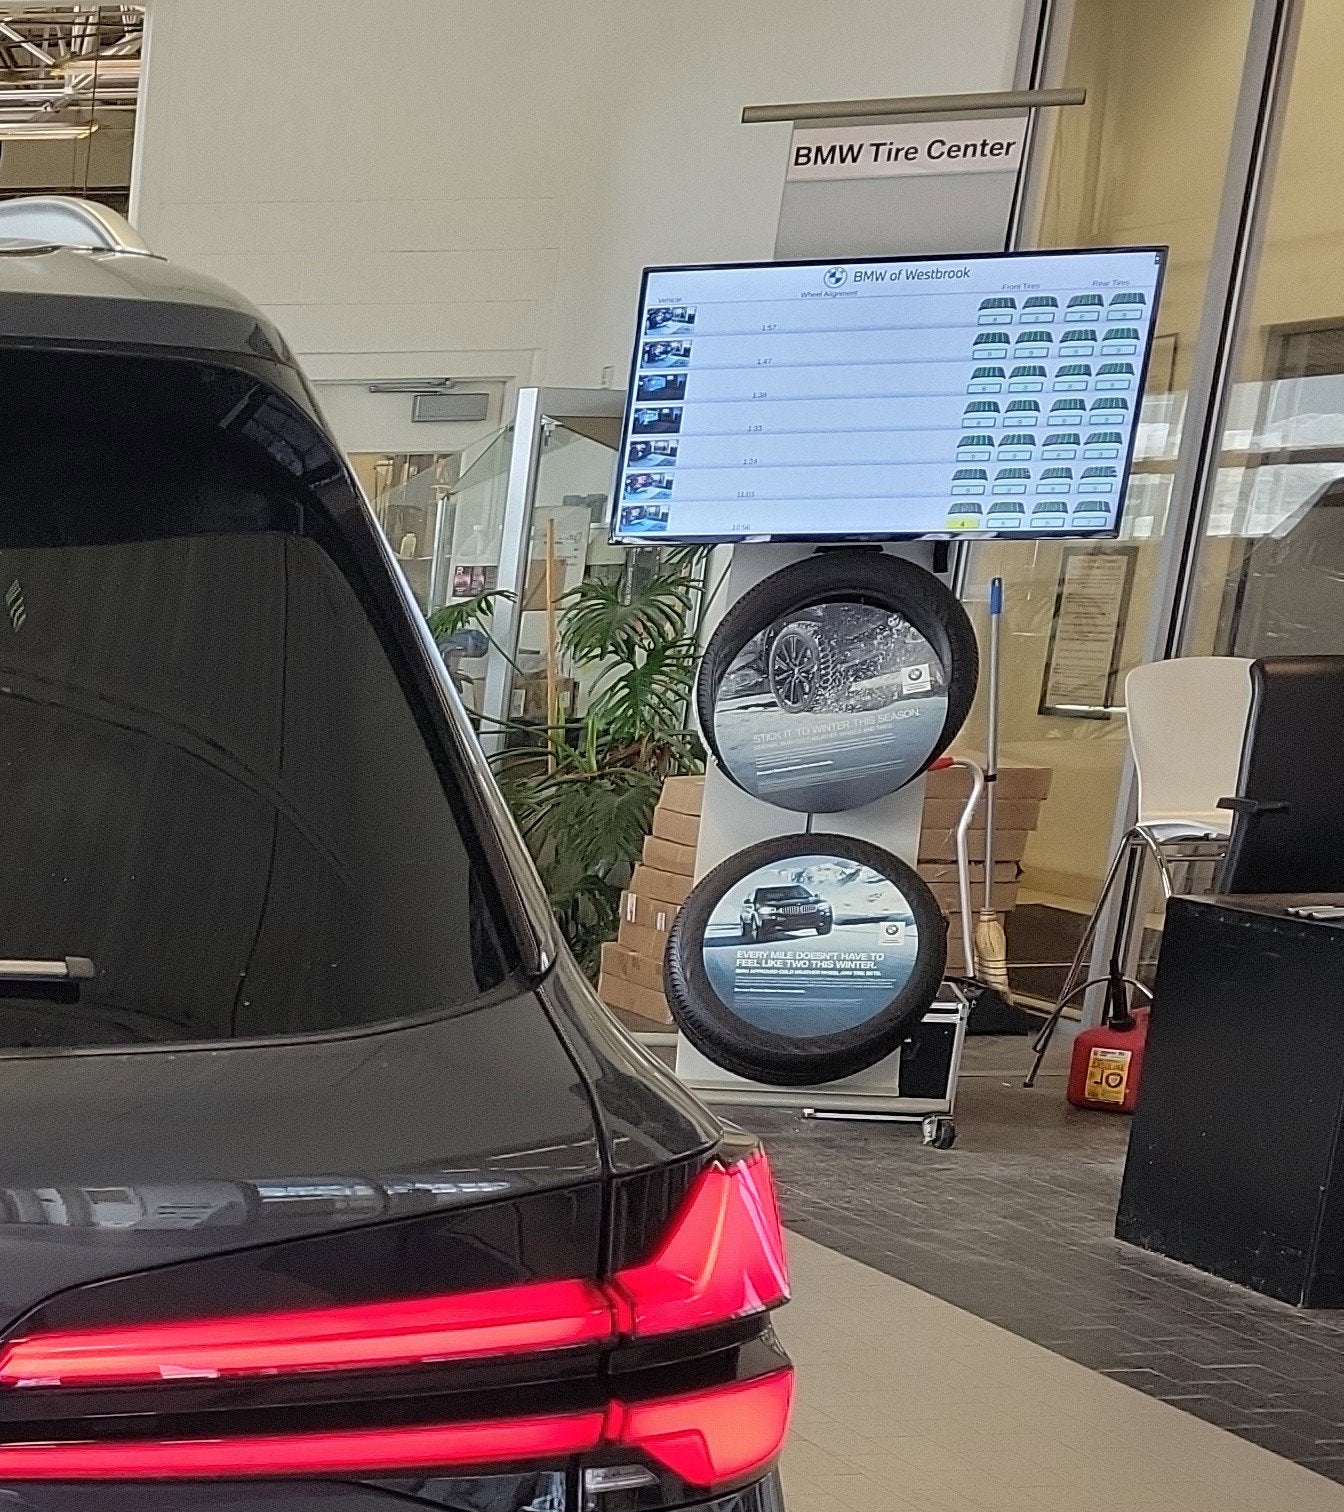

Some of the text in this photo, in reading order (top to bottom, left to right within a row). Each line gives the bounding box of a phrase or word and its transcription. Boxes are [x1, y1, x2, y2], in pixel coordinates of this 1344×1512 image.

[794, 138, 1017, 167] BMW Tire Center
[853, 267, 971, 283] BMW of Westbrook
[823, 290, 858, 299] Alignment
[753, 731, 782, 743] STICK
[796, 727, 810, 736] TO
[812, 720, 850, 733] WINTER
[854, 716, 876, 726] THIS
[878, 708, 922, 722] SEASON.
[737, 951, 884, 960] EVERY MILE DOESN'T HAVE TO
[736, 959, 877, 969] FEEL LIKE TWO THIS WINTER.
